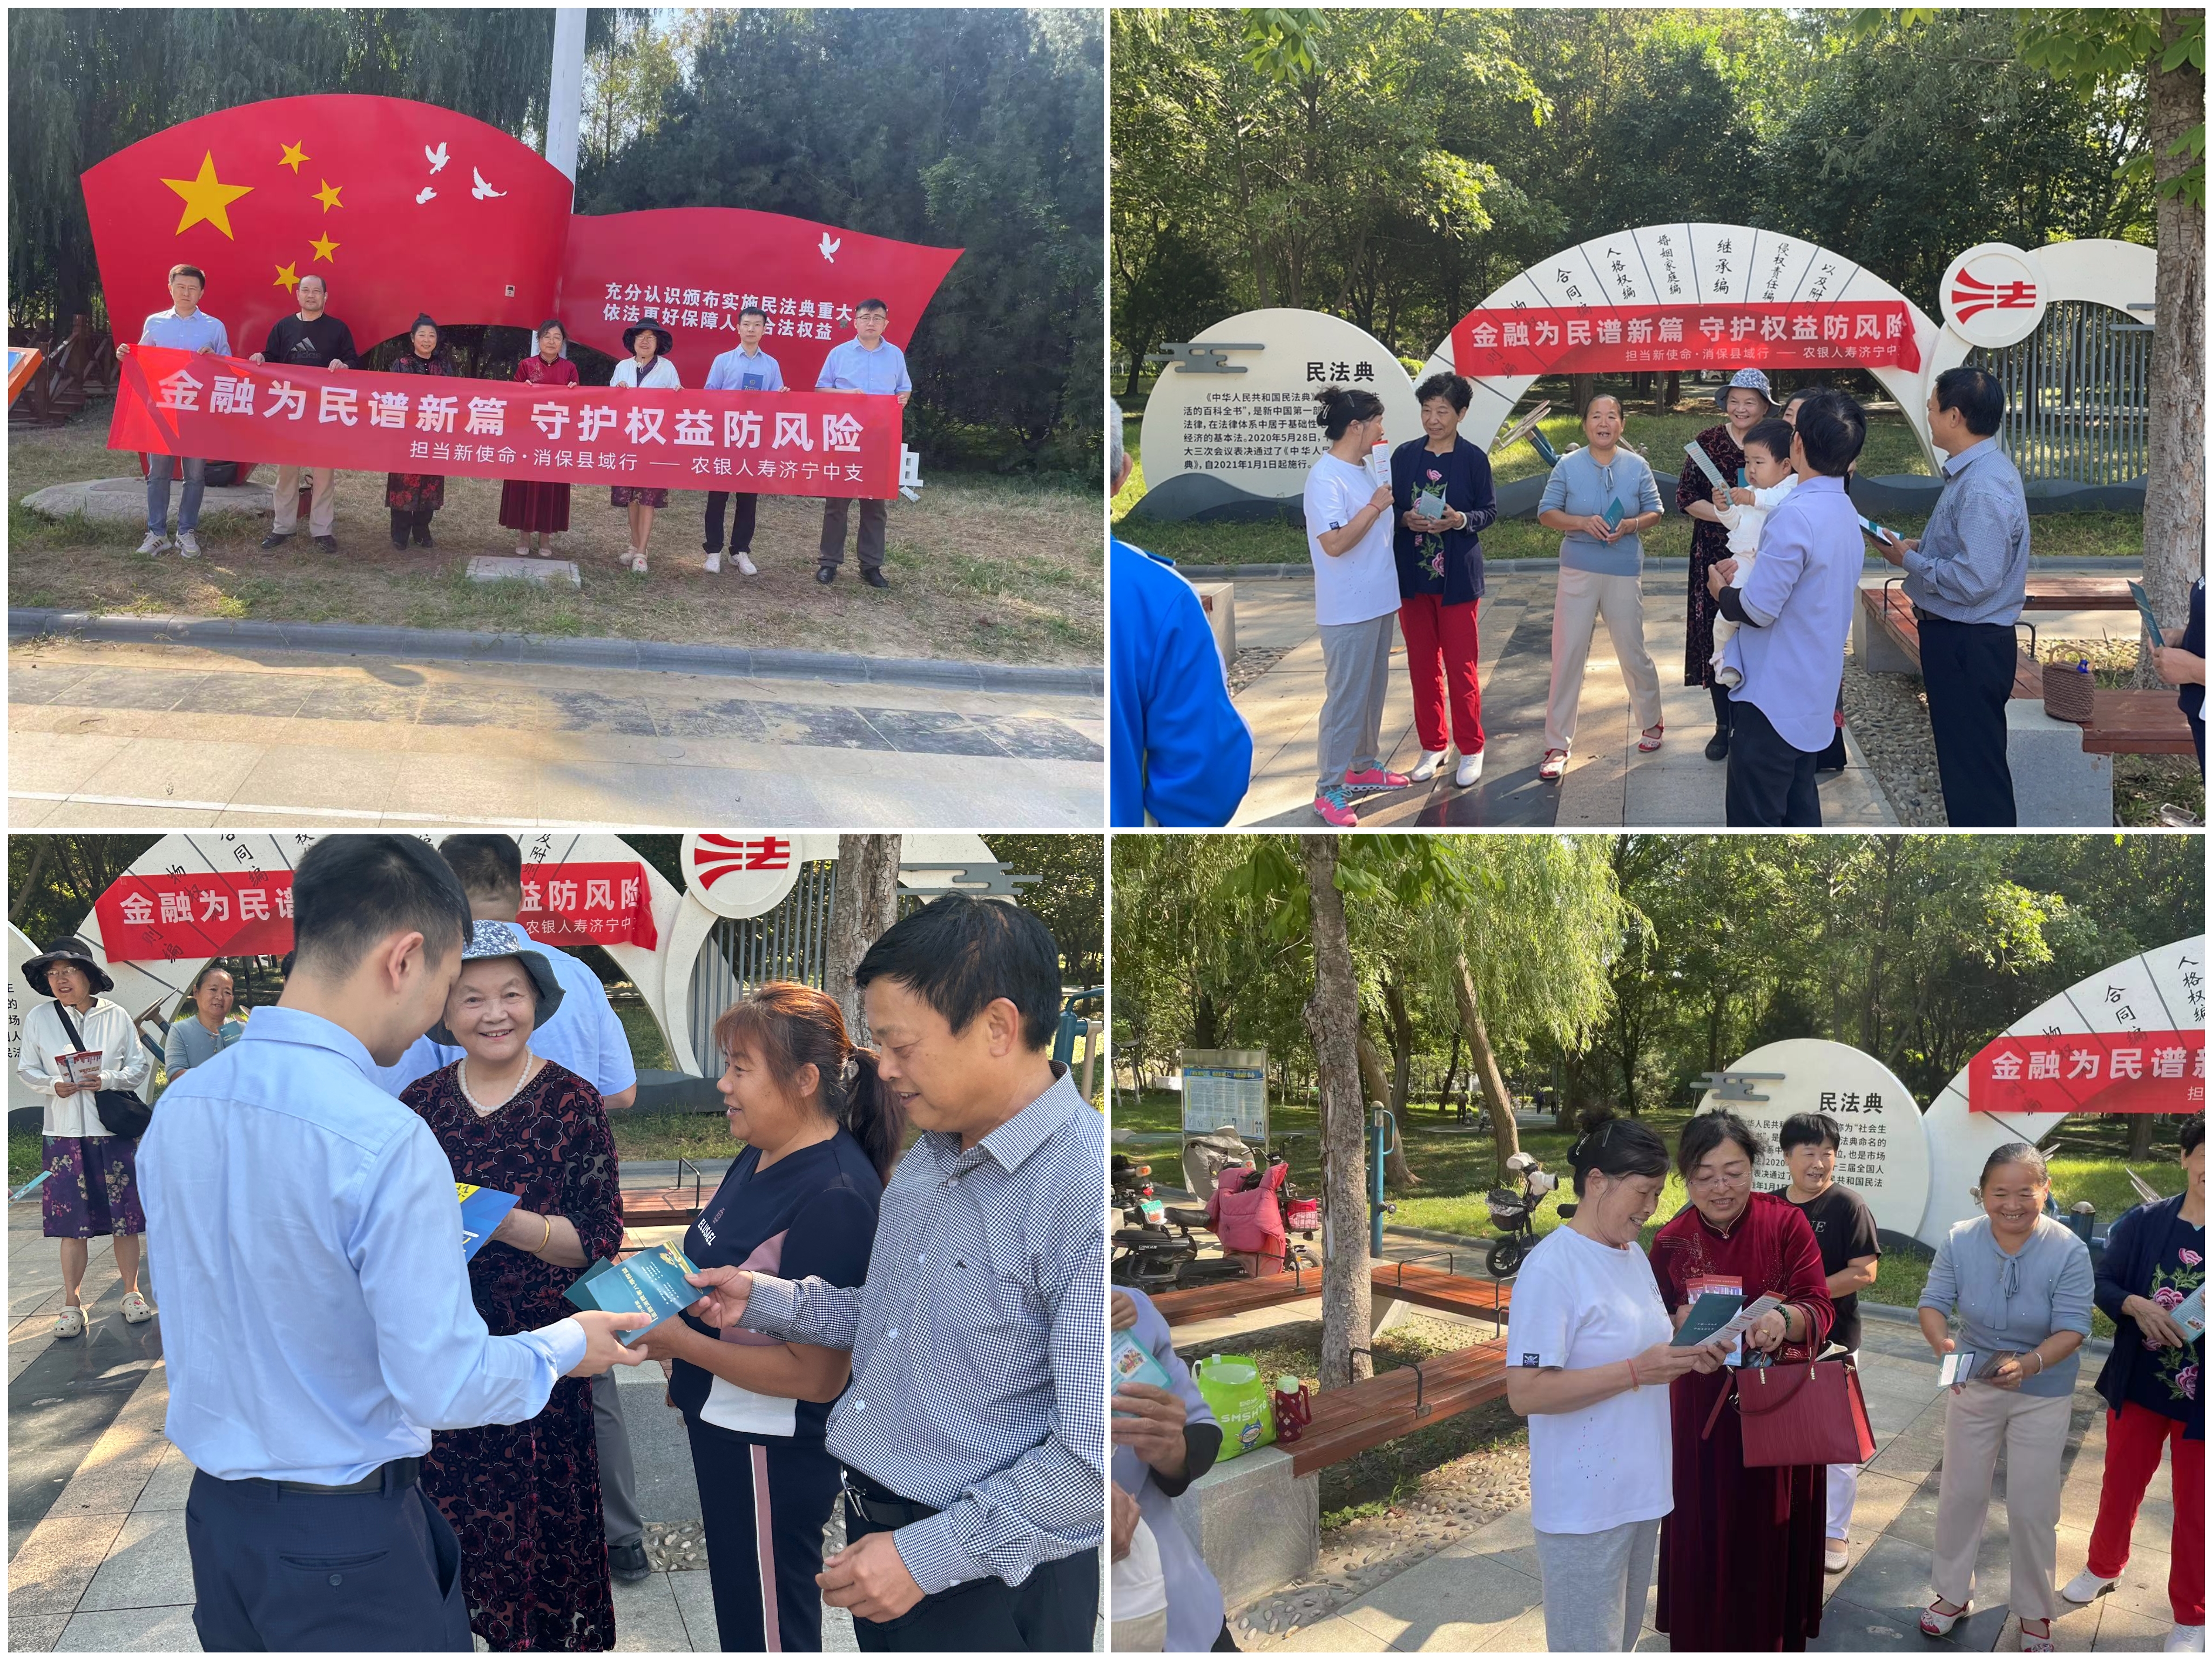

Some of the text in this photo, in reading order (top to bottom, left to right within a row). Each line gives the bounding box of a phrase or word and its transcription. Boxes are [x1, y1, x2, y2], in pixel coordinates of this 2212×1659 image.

[1607, 248, 1636, 299] 人格权编
[1657, 234, 1681, 295] 婚姻家庭编
[1713, 238, 1732, 294] 继承编
[1762, 242, 1789, 303] 侵权责任编
[604, 282, 889, 322] 充分认识颁布实施民法典重大
[603, 304, 833, 341] 依法更好保障人合法权益
[1472, 313, 1907, 348] 金融为民谱新篇 守护权益防风险
[1307, 361, 1374, 382] 民法典
[1626, 344, 1901, 362] 担当新使命·消保县域行 农银人寿济宁中
[156, 370, 864, 453] 金融为民谱新篇 守护权益防风险
[410, 440, 638, 471] 担当新使命·消保县域行
[691, 455, 864, 482] 农银人寿济宁中支
[525, 916, 636, 934] 农银人寿济宁中
[1819, 1092, 1883, 1114] 民法典
